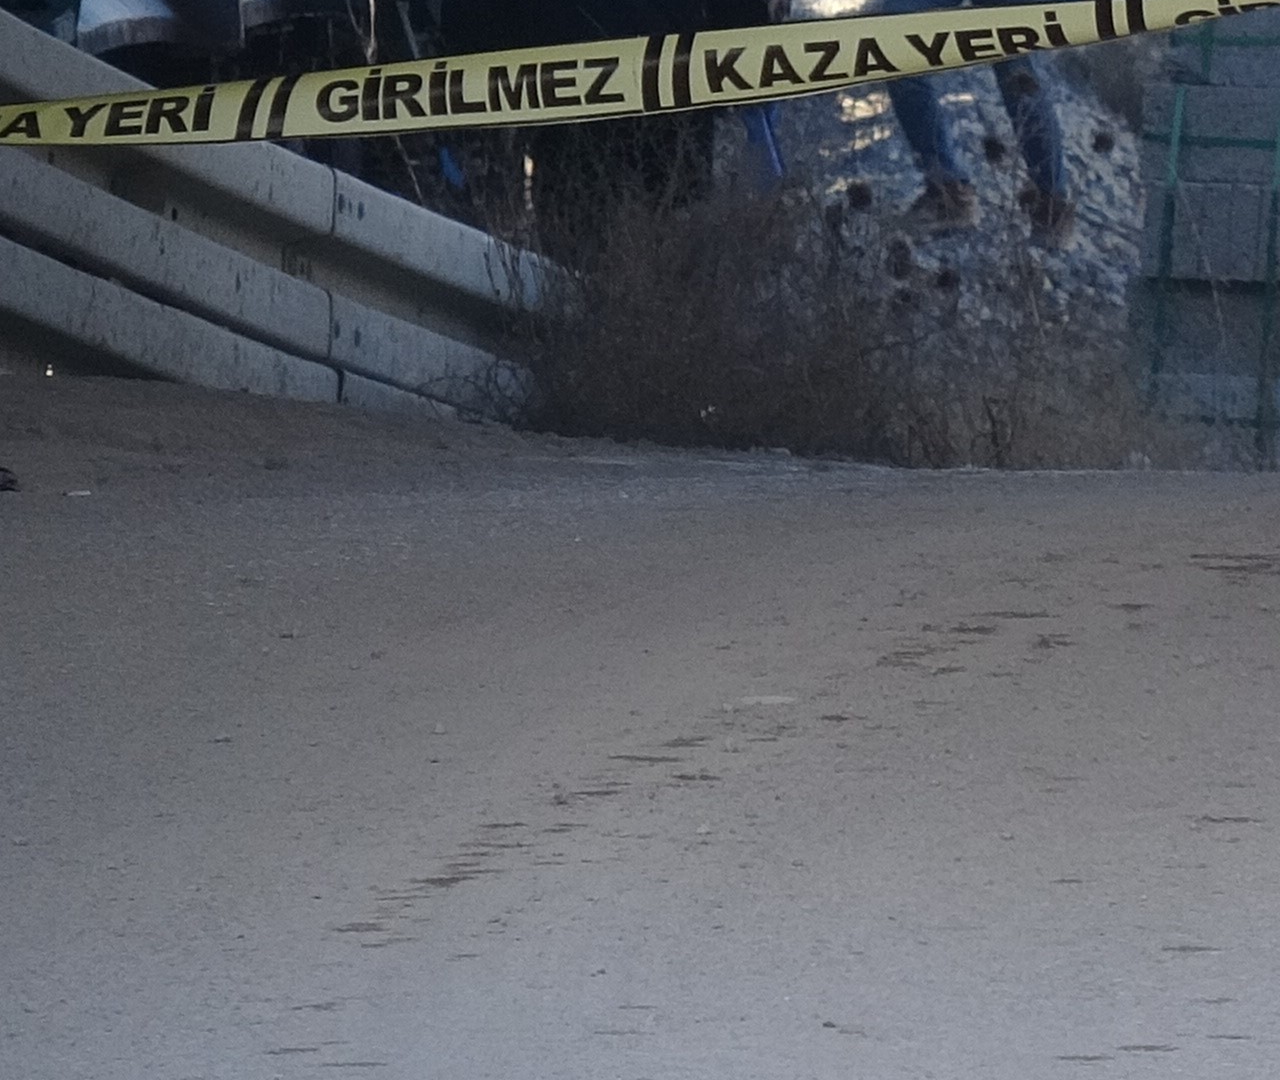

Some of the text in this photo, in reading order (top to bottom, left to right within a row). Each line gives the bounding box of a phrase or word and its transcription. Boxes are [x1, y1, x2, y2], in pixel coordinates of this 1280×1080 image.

[704, 11, 1071, 94] KAZA YERİ
[64, 86, 216, 138] YERİ
[316, 56, 625, 122] GİRİLMEZ
